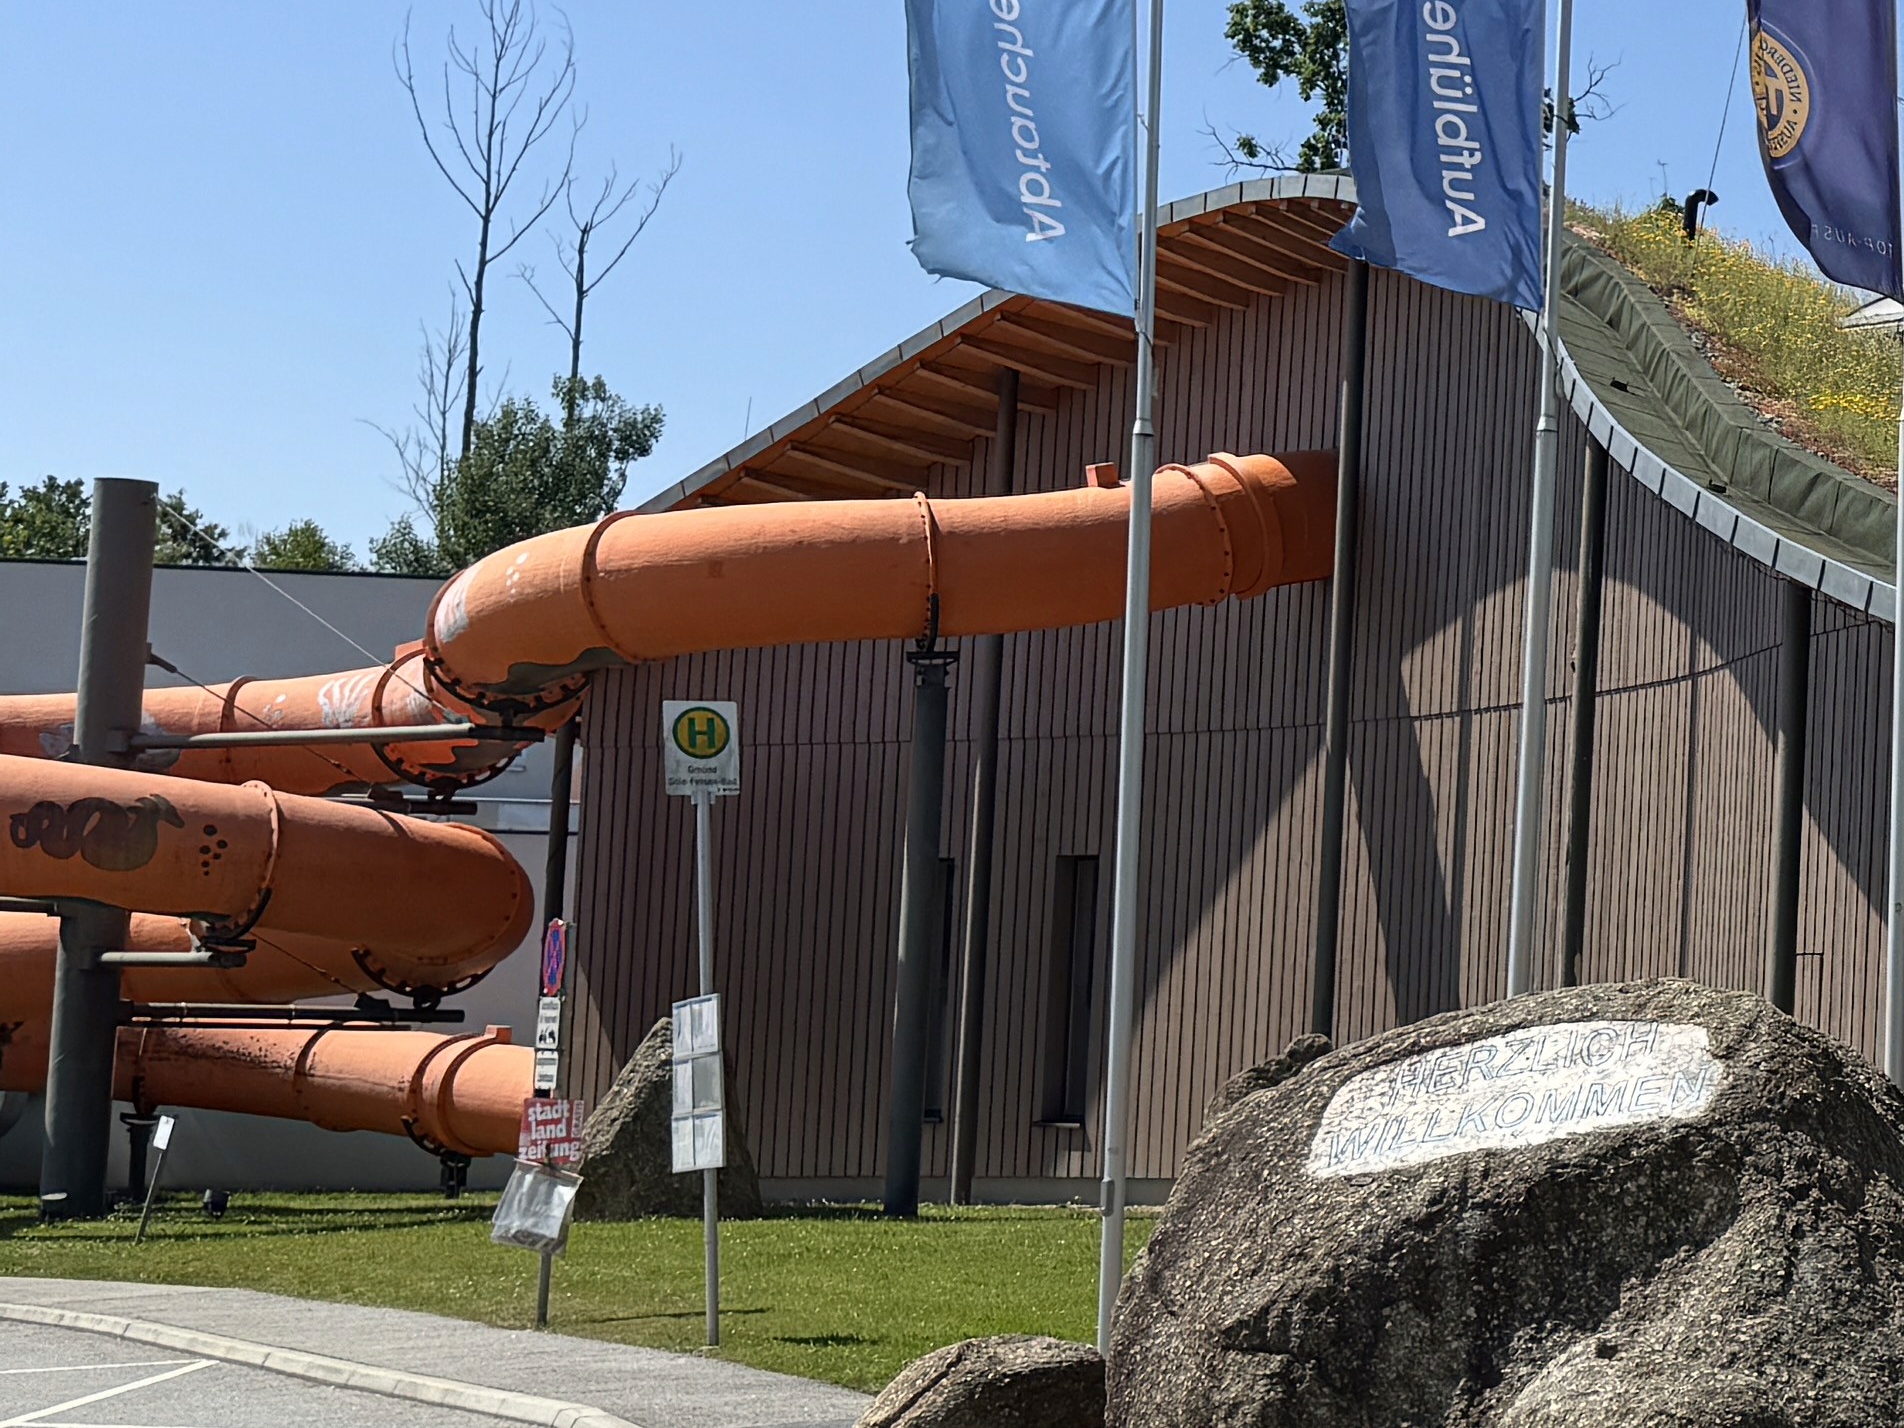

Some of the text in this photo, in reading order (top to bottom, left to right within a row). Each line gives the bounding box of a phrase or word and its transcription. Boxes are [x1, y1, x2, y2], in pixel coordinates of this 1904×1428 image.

[688, 717, 716, 749] H
[1389, 1021, 1660, 1110] HERZLICH
[528, 1100, 569, 1121] stadt
[1326, 1068, 1710, 1170] WILLKOMMEN
[531, 1118, 567, 1140] land
